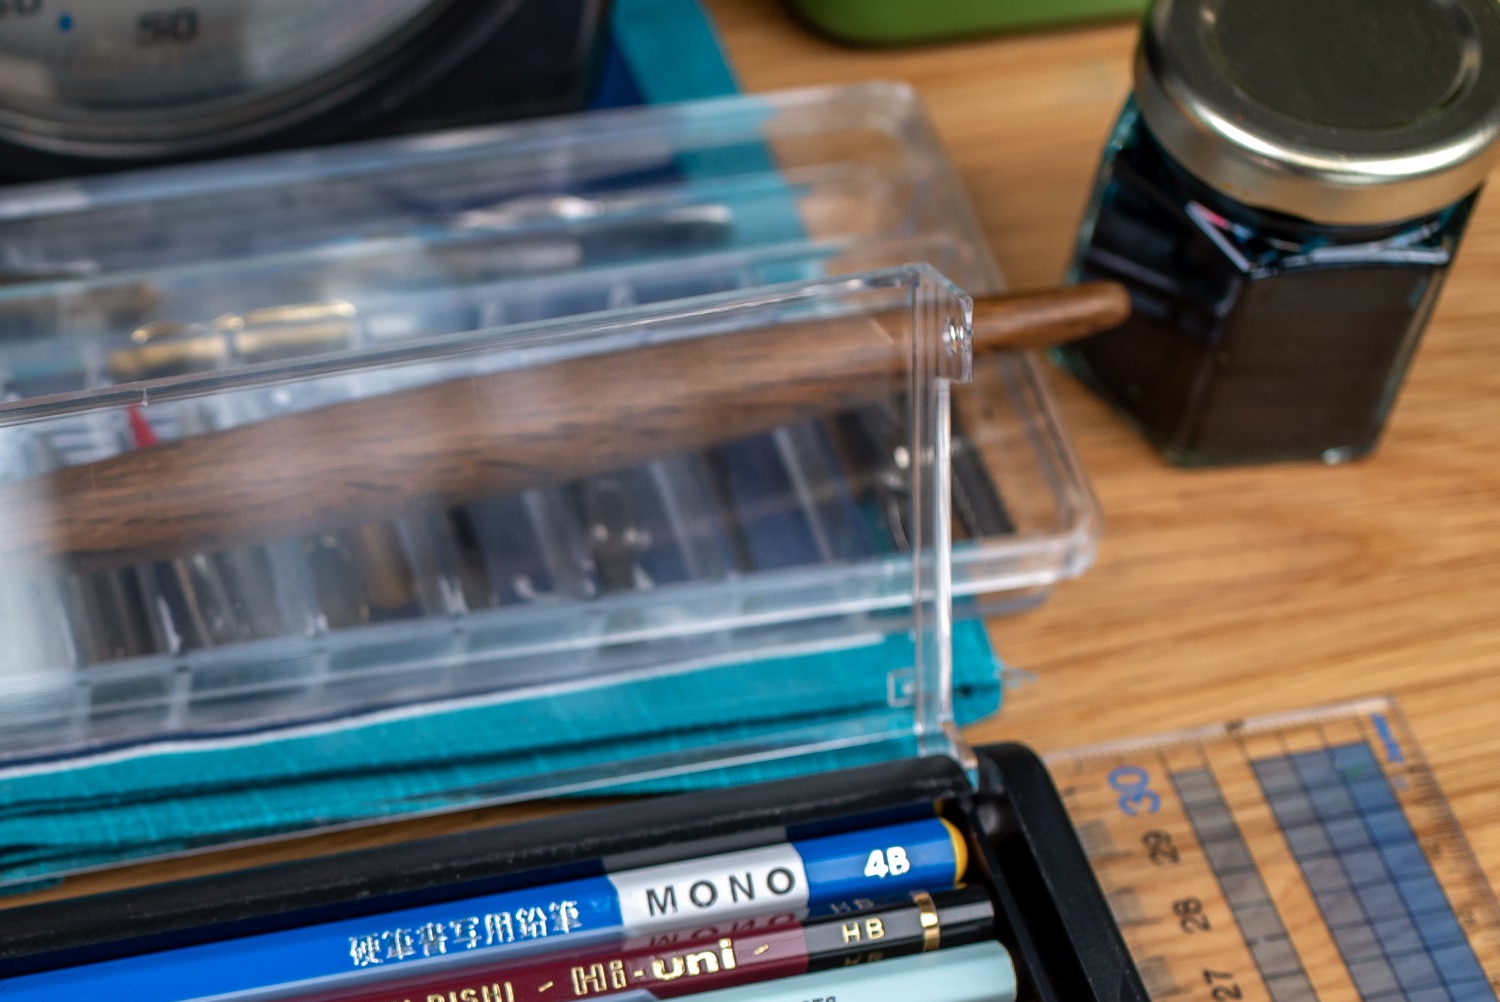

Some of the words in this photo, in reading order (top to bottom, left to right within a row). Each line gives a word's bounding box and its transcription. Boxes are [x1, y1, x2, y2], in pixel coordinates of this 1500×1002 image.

[1107, 765, 1160, 816] 30
[863, 846, 911, 878] 4B
[1141, 829, 1180, 866] 29
[645, 866, 797, 918] MONO
[841, 918, 886, 944] HB
[1173, 896, 1211, 933] 28
[1204, 968, 1243, 1002] 27
